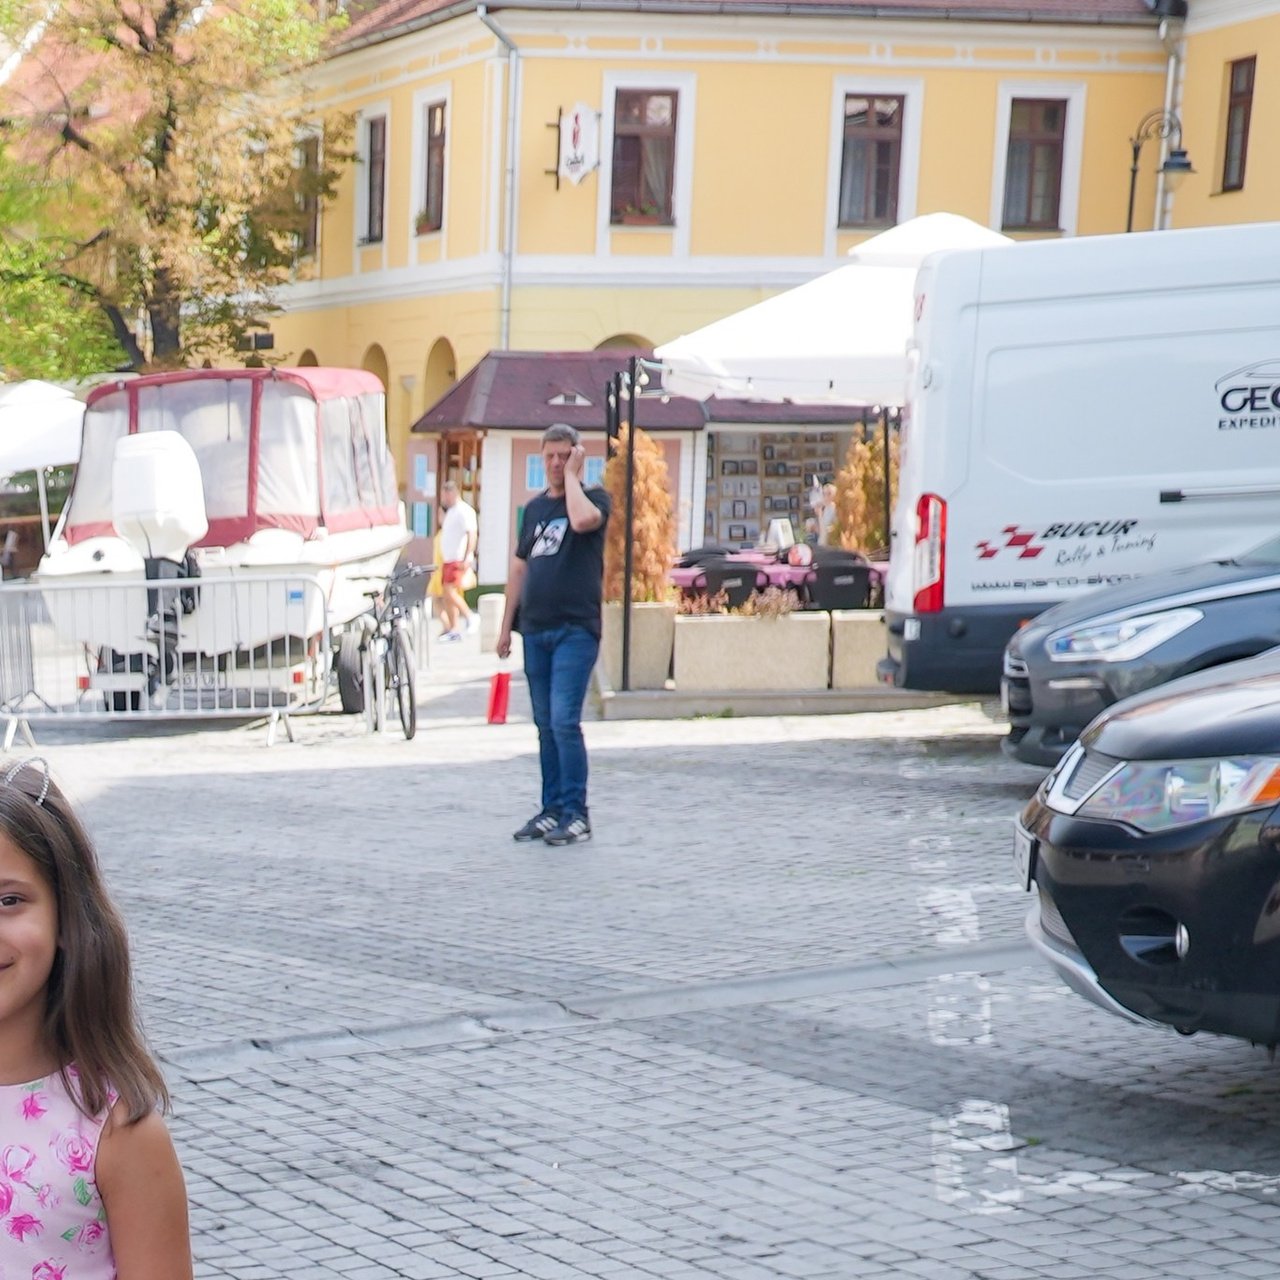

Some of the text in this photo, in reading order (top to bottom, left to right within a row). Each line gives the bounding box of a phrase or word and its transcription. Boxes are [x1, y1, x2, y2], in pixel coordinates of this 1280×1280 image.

[1218, 415, 1280, 430] EXPEDI
[1041, 520, 1139, 539] BUCUR
[1055, 544, 1093, 566] Rally
[1111, 533, 1157, 552] Tuning
